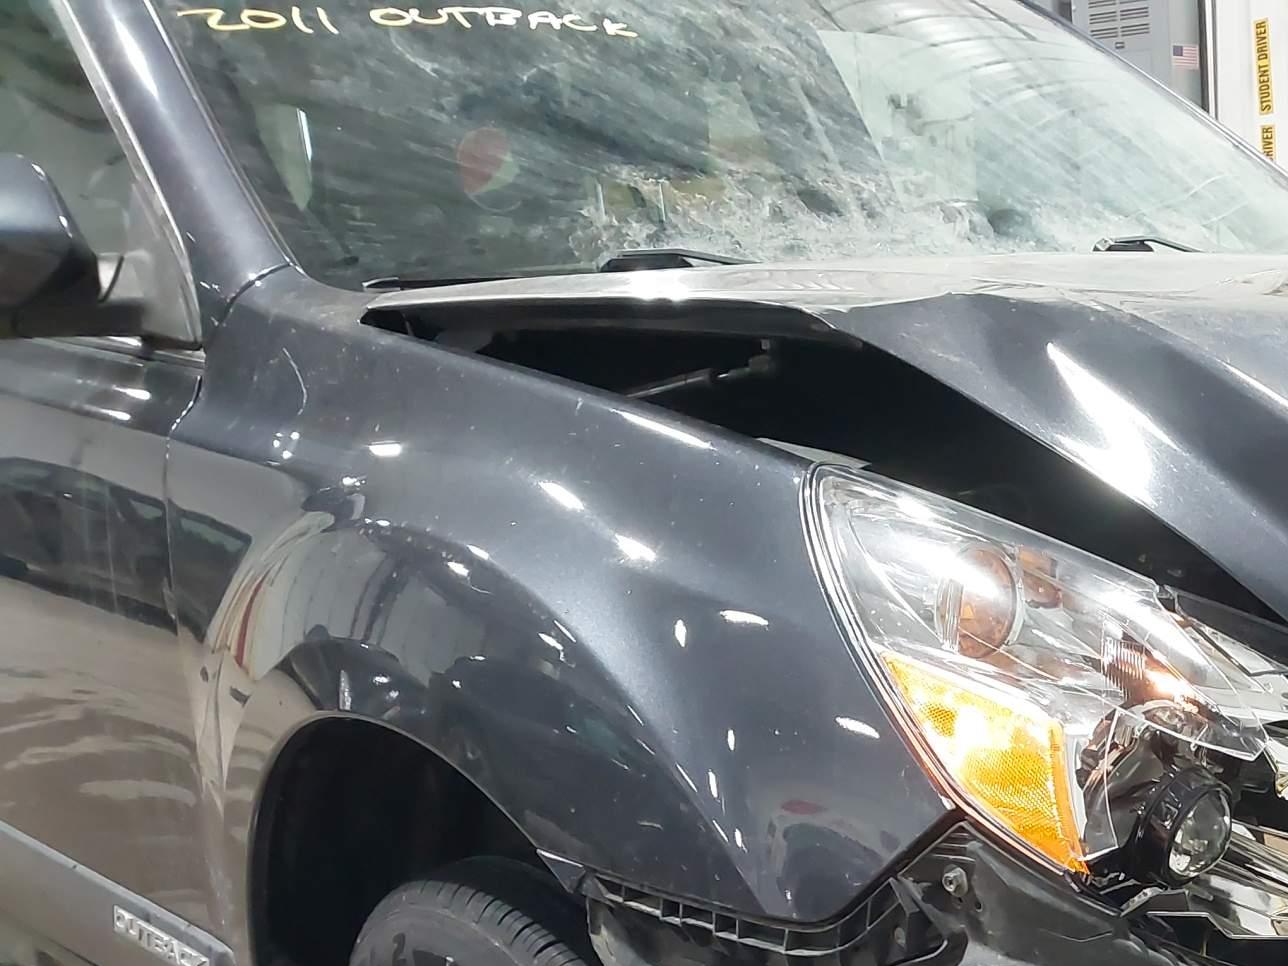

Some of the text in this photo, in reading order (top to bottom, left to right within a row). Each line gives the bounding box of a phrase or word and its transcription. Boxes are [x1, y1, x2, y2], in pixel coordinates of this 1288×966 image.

[177, 6, 639, 38] 2011 OUTBACK
[1256, 20, 1272, 112] STUDENT DRIVER
[1262, 127, 1275, 161] RIVER
